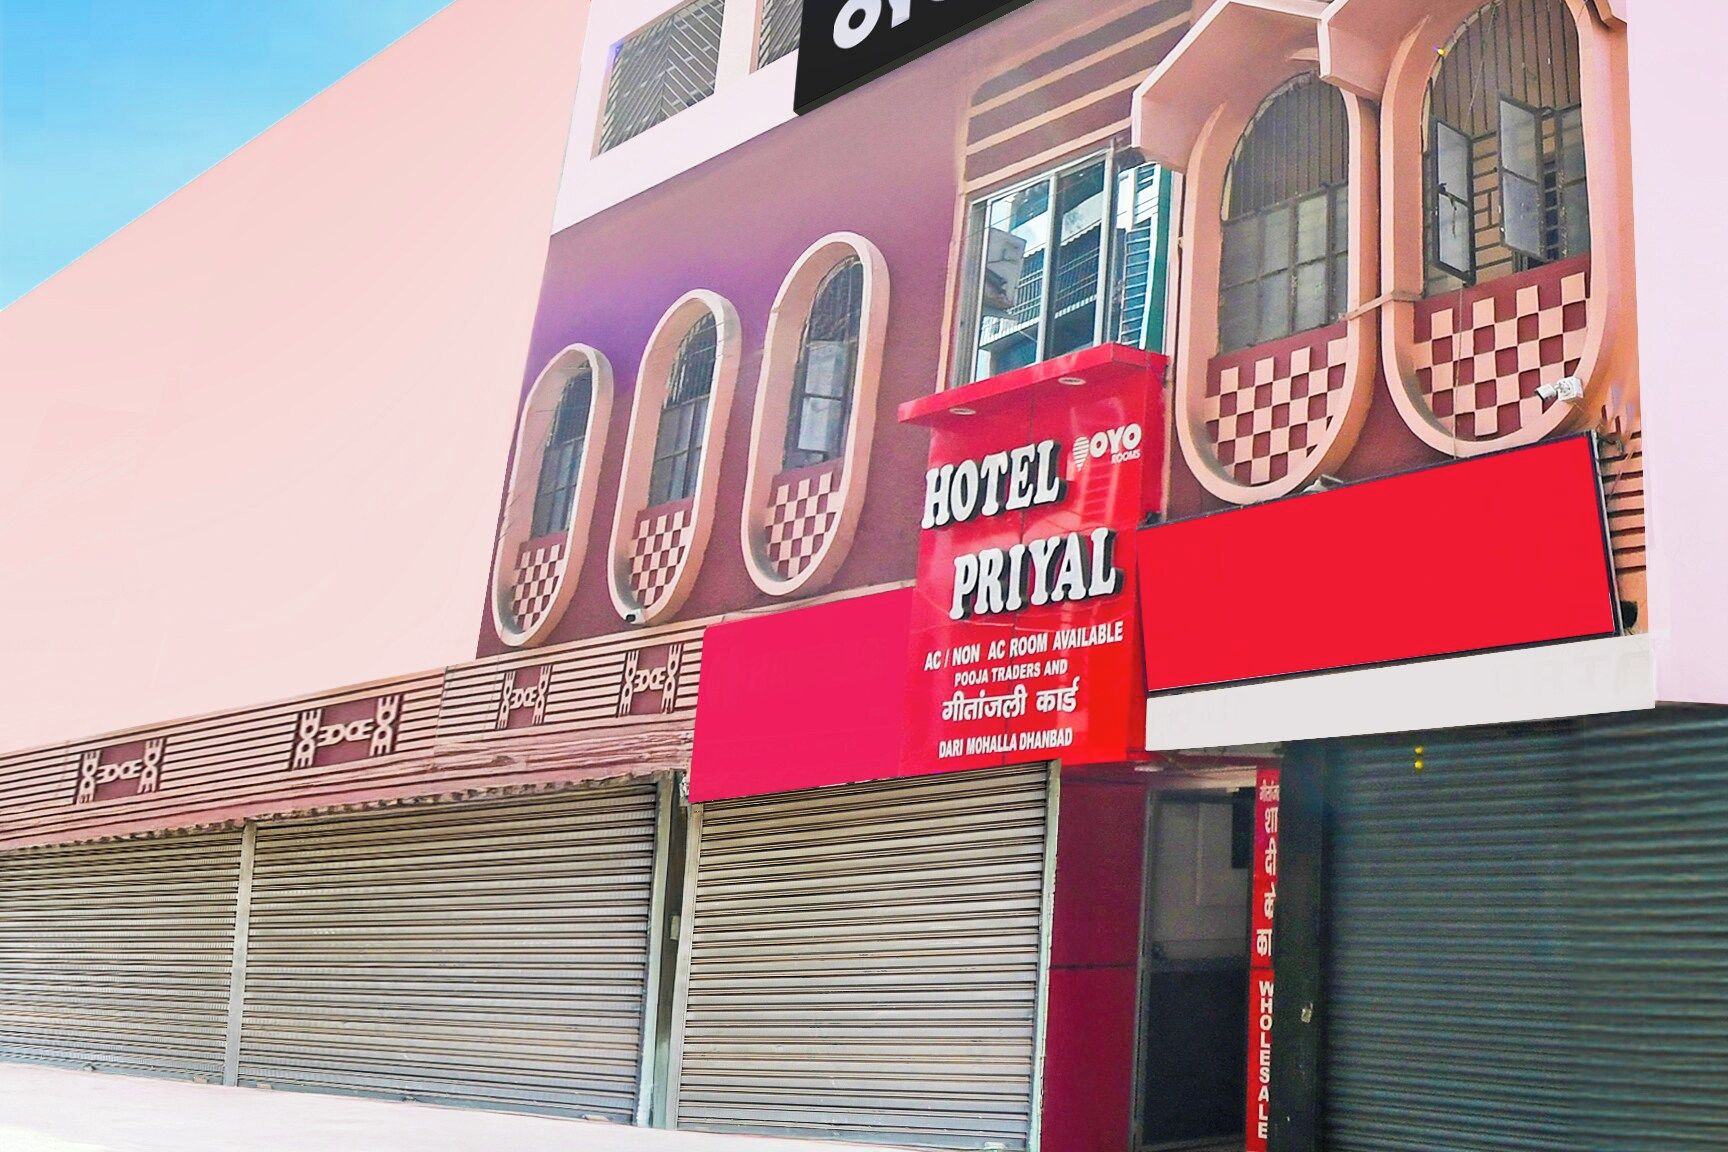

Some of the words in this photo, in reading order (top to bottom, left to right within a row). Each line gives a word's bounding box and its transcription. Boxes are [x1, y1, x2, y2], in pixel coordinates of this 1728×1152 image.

[1089, 423, 1142, 458] OYO
[1111, 449, 1141, 464] ROOMS
[921, 439, 1062, 530] HOTEL
[949, 527, 1119, 621] PRIYAL
[924, 651, 942, 671] AC
[952, 644, 980, 667] NON
[988, 639, 1005, 660] AC
[1009, 632, 1048, 658] ROOM
[1052, 621, 1124, 651] AVAILABLE
[954, 667, 989, 687] POOJA
[991, 662, 1041, 683] TRADERS
[1044, 659, 1068, 676] AND
[941, 684, 1028, 722] गीतांजली
[1035, 676, 1080, 713] कार्ड
[938, 738, 963, 758] DARI
[966, 732, 1017, 755] MOHALLA
[1018, 727, 1073, 751] DHANBAD
[1257, 980, 1275, 1140] WHOLESALE
